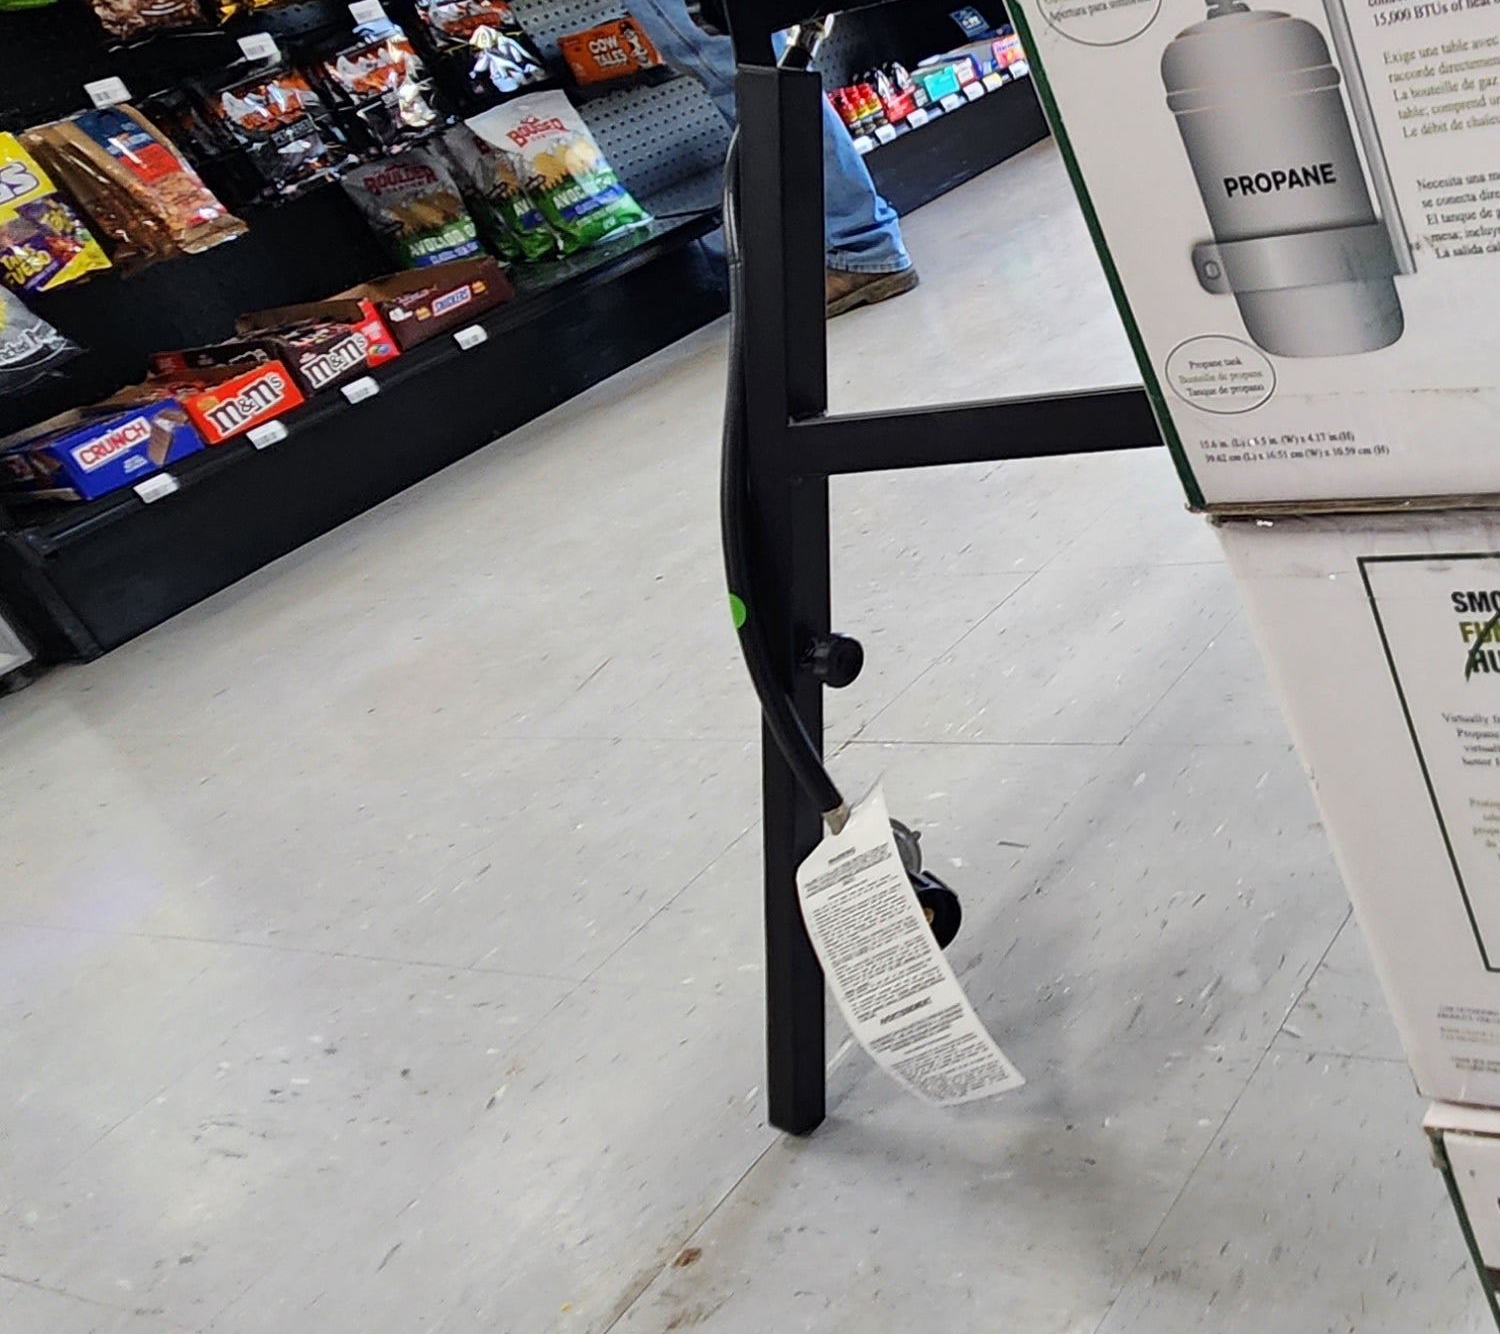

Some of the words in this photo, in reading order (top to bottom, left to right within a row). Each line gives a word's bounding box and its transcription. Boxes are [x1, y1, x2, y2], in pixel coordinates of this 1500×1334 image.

[1372, 7, 1415, 31] 15,000
[1411, 0, 1449, 19] BTUs
[588, 35, 620, 55] COW
[593, 46, 628, 68] TALES
[363, 163, 439, 196] BOULDER
[1223, 162, 1337, 198] PROPANE
[79, 421, 148, 466] CRUNCH
